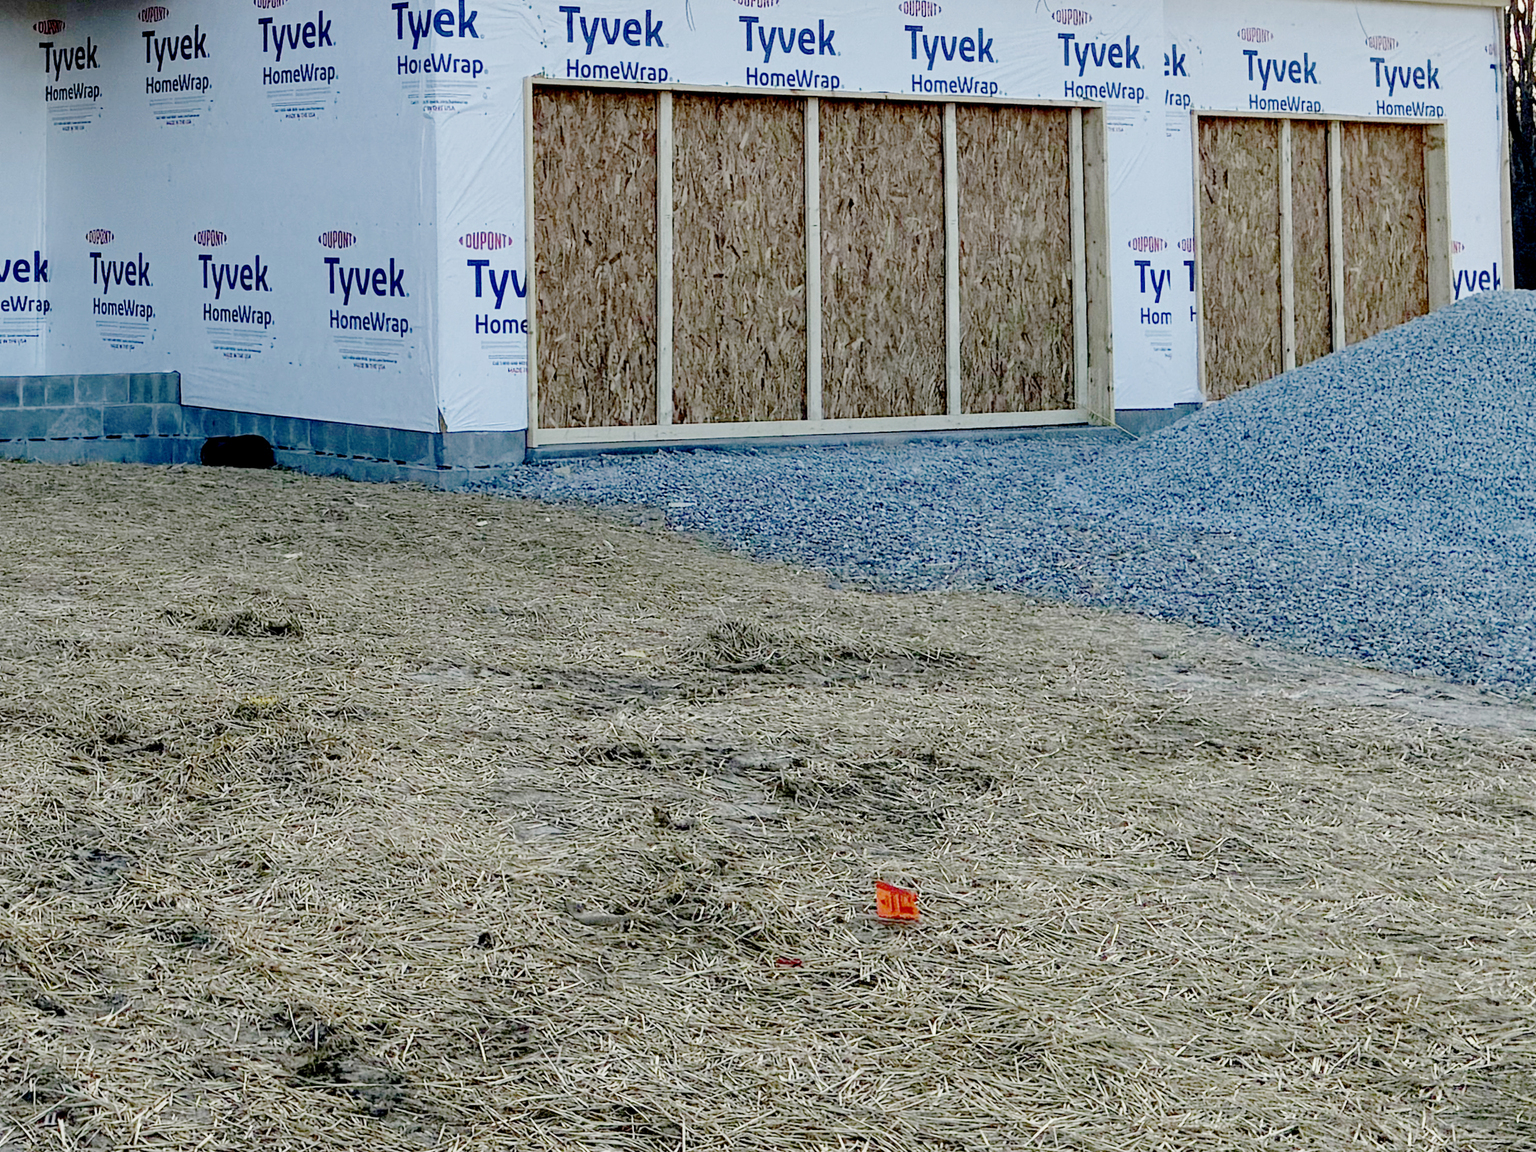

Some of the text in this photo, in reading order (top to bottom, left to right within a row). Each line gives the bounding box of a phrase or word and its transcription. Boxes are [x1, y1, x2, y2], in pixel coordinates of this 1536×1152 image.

[903, 0, 938, 17] DUPONT
[1056, 9, 1089, 26] DUPONT
[258, 10, 333, 61] Tyvek
[392, 0, 479, 50] Tyvek
[559, 6, 664, 55] Tyvek
[1241, 28, 1270, 43] DUPONT
[142, 24, 207, 72] Tyvek
[739, 16, 836, 63] Tyvek
[905, 25, 994, 71] Tyvek
[1369, 36, 1397, 51] DUPONT
[39, 37, 98, 81] Tyvek
[1058, 33, 1141, 77] Tyvek
[263, 64, 335, 85] HomeWrap
[566, 59, 668, 83] HomeWrap
[746, 67, 840, 89] HomeWrap
[1243, 50, 1317, 90] Tyvek
[1370, 57, 1440, 96] Tyvek
[45, 83, 99, 101] HomeWrap
[146, 74, 209, 93] HomeWrap
[912, 74, 998, 97] HomeWrap
[1065, 81, 1144, 104] HomeWrap
[1249, 94, 1321, 113] HomeWrap
[1376, 100, 1444, 119] HomeWrap
[198, 229, 224, 247] DUPONT
[322, 230, 352, 249] DUPONT
[466, 231, 507, 250] DUPONT
[1132, 236, 1164, 253] DUPONT
[90, 252, 151, 294] Tyvek
[198, 254, 268, 299] Tyvek
[324, 257, 406, 306] Tyvek
[93, 298, 153, 321] HomeWrap
[203, 303, 272, 329] HomeWrap
[330, 310, 409, 337] HomeWrap
